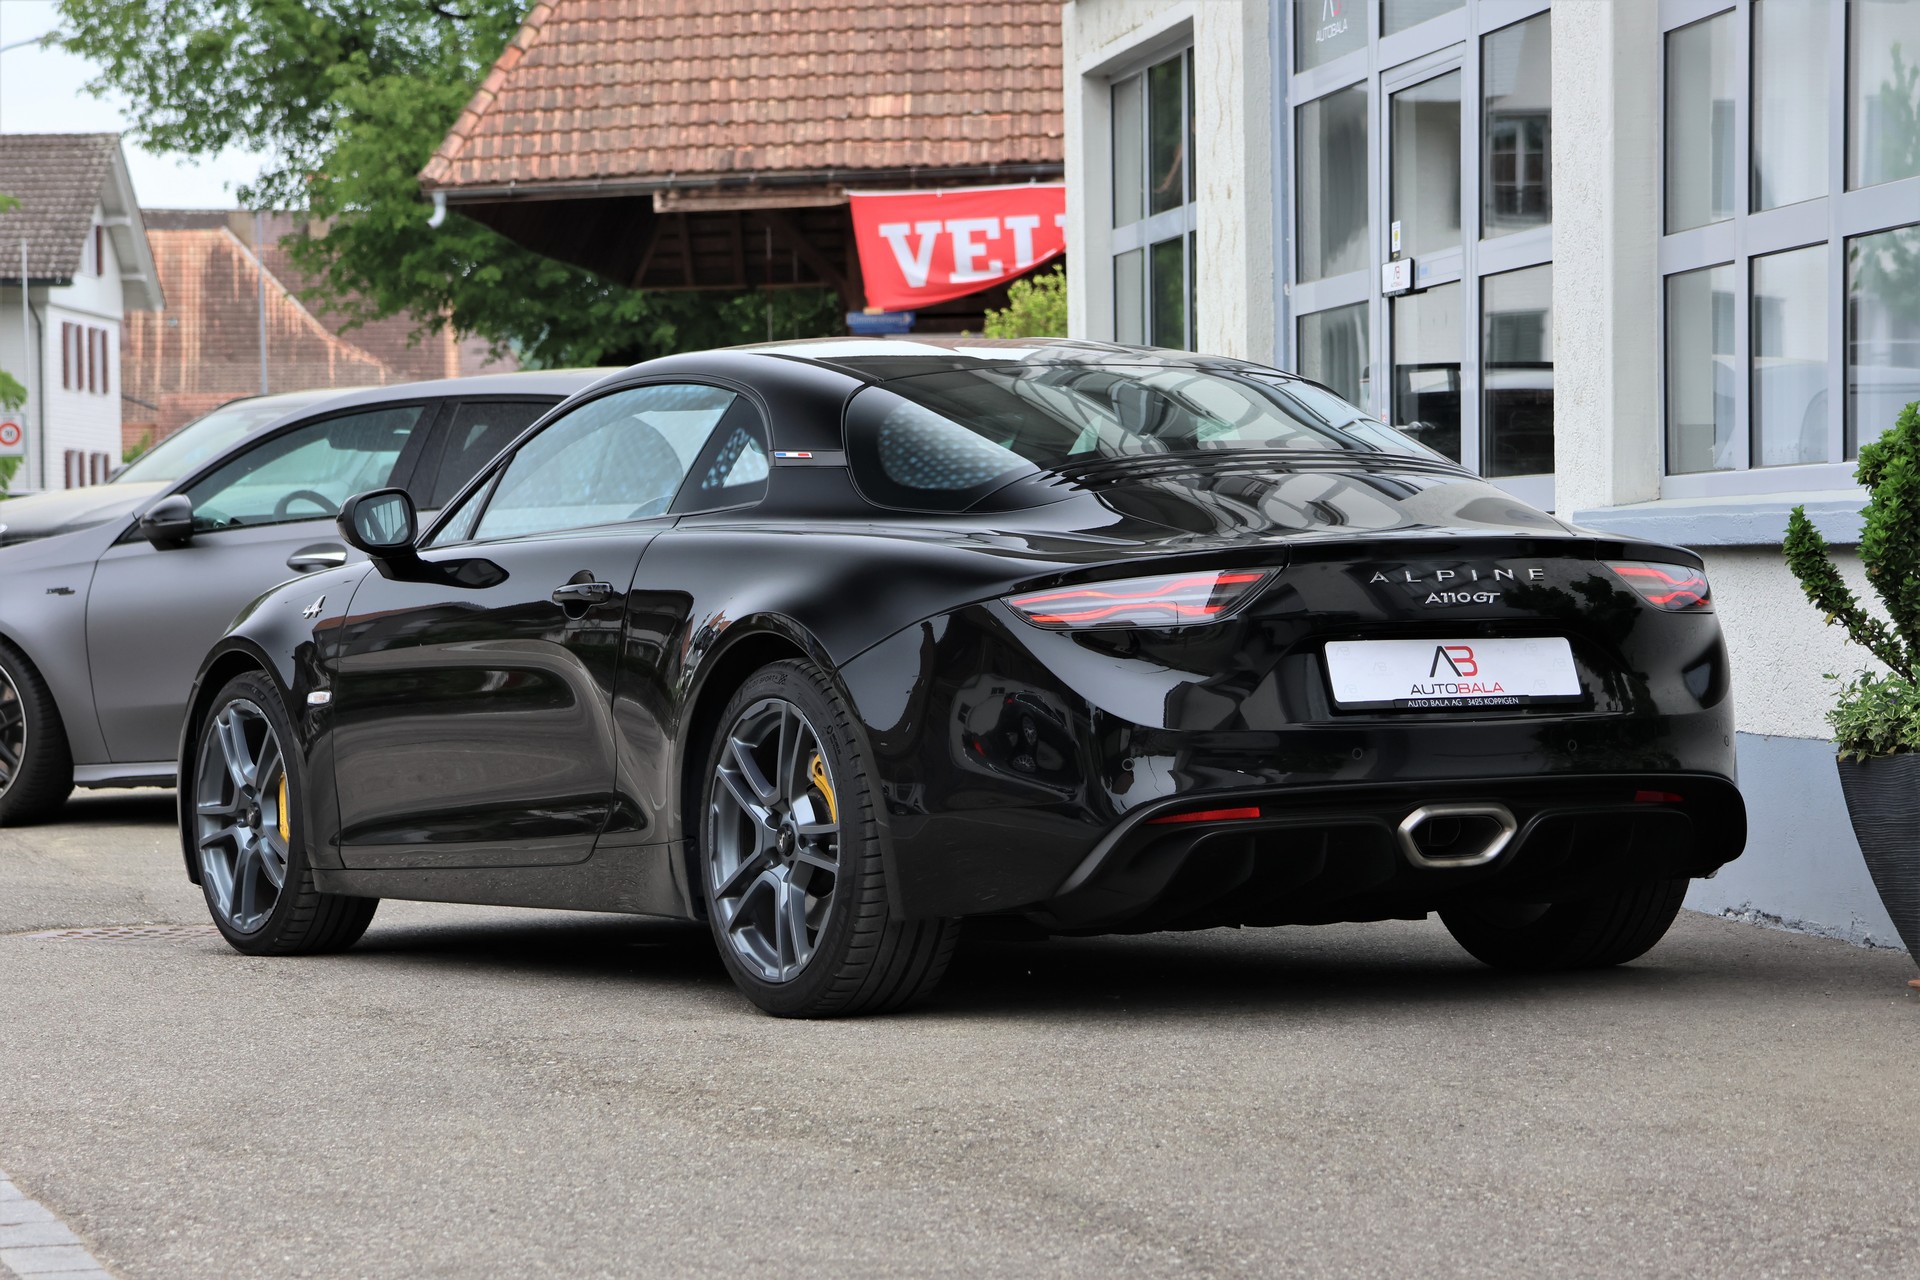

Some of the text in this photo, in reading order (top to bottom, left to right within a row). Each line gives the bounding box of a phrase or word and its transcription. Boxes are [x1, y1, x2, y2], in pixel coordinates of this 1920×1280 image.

[1370, 568, 1545, 584] ALPINE
[1410, 682, 1504, 695] AUTOBALA
[1407, 700, 1429, 708] AUTO
[1430, 699, 1450, 707] BALA
[1451, 698, 1462, 706] AG
[1484, 697, 1519, 705] KOPPIGEN
